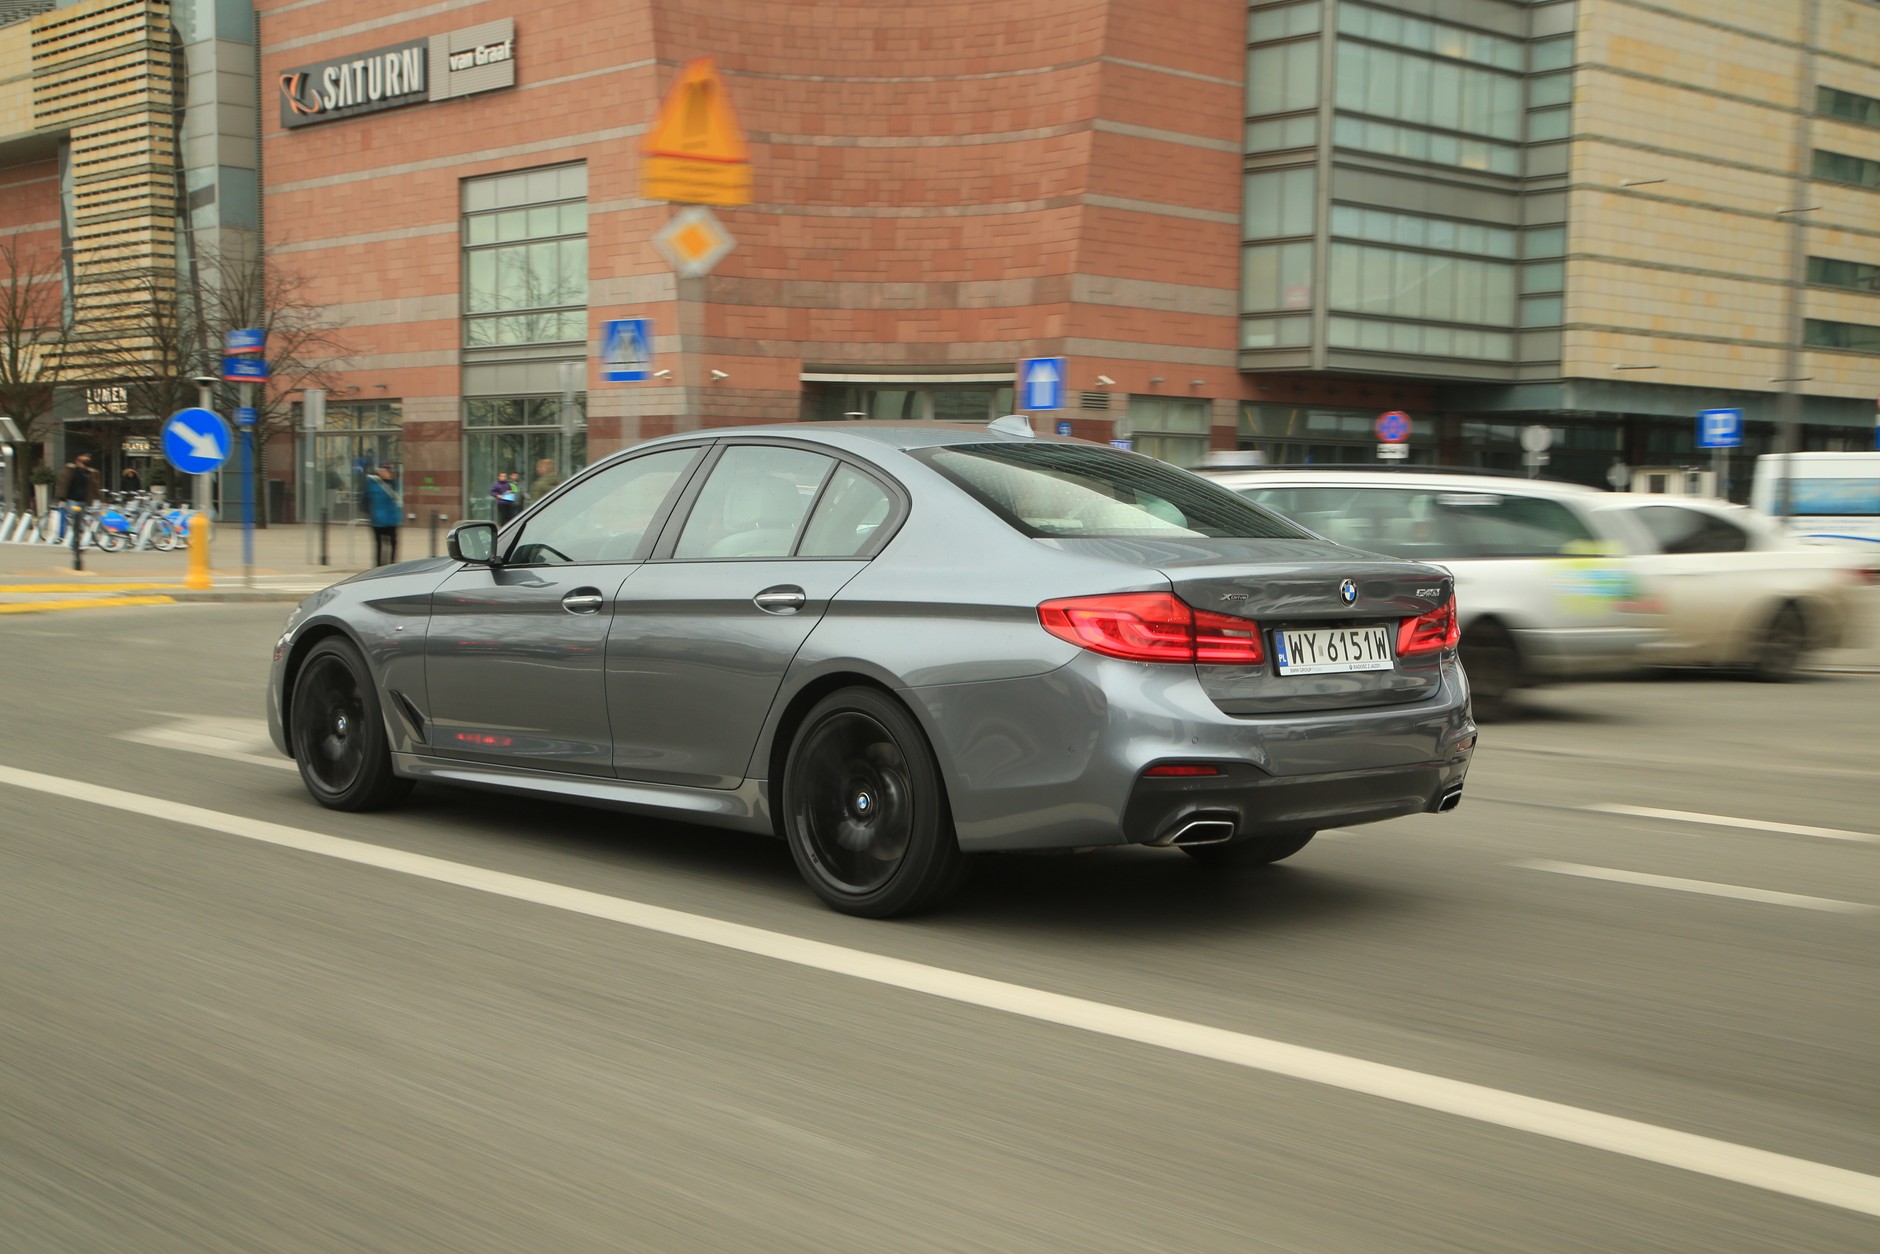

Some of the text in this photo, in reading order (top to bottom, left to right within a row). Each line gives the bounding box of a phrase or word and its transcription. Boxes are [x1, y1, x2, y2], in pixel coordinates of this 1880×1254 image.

[449, 41, 513, 72] van Graaf
[323, 47, 421, 110] SATURN
[86, 387, 127, 403] LUMEN
[1279, 654, 1286, 662] PL
[1288, 631, 1387, 664] WY 6151W
